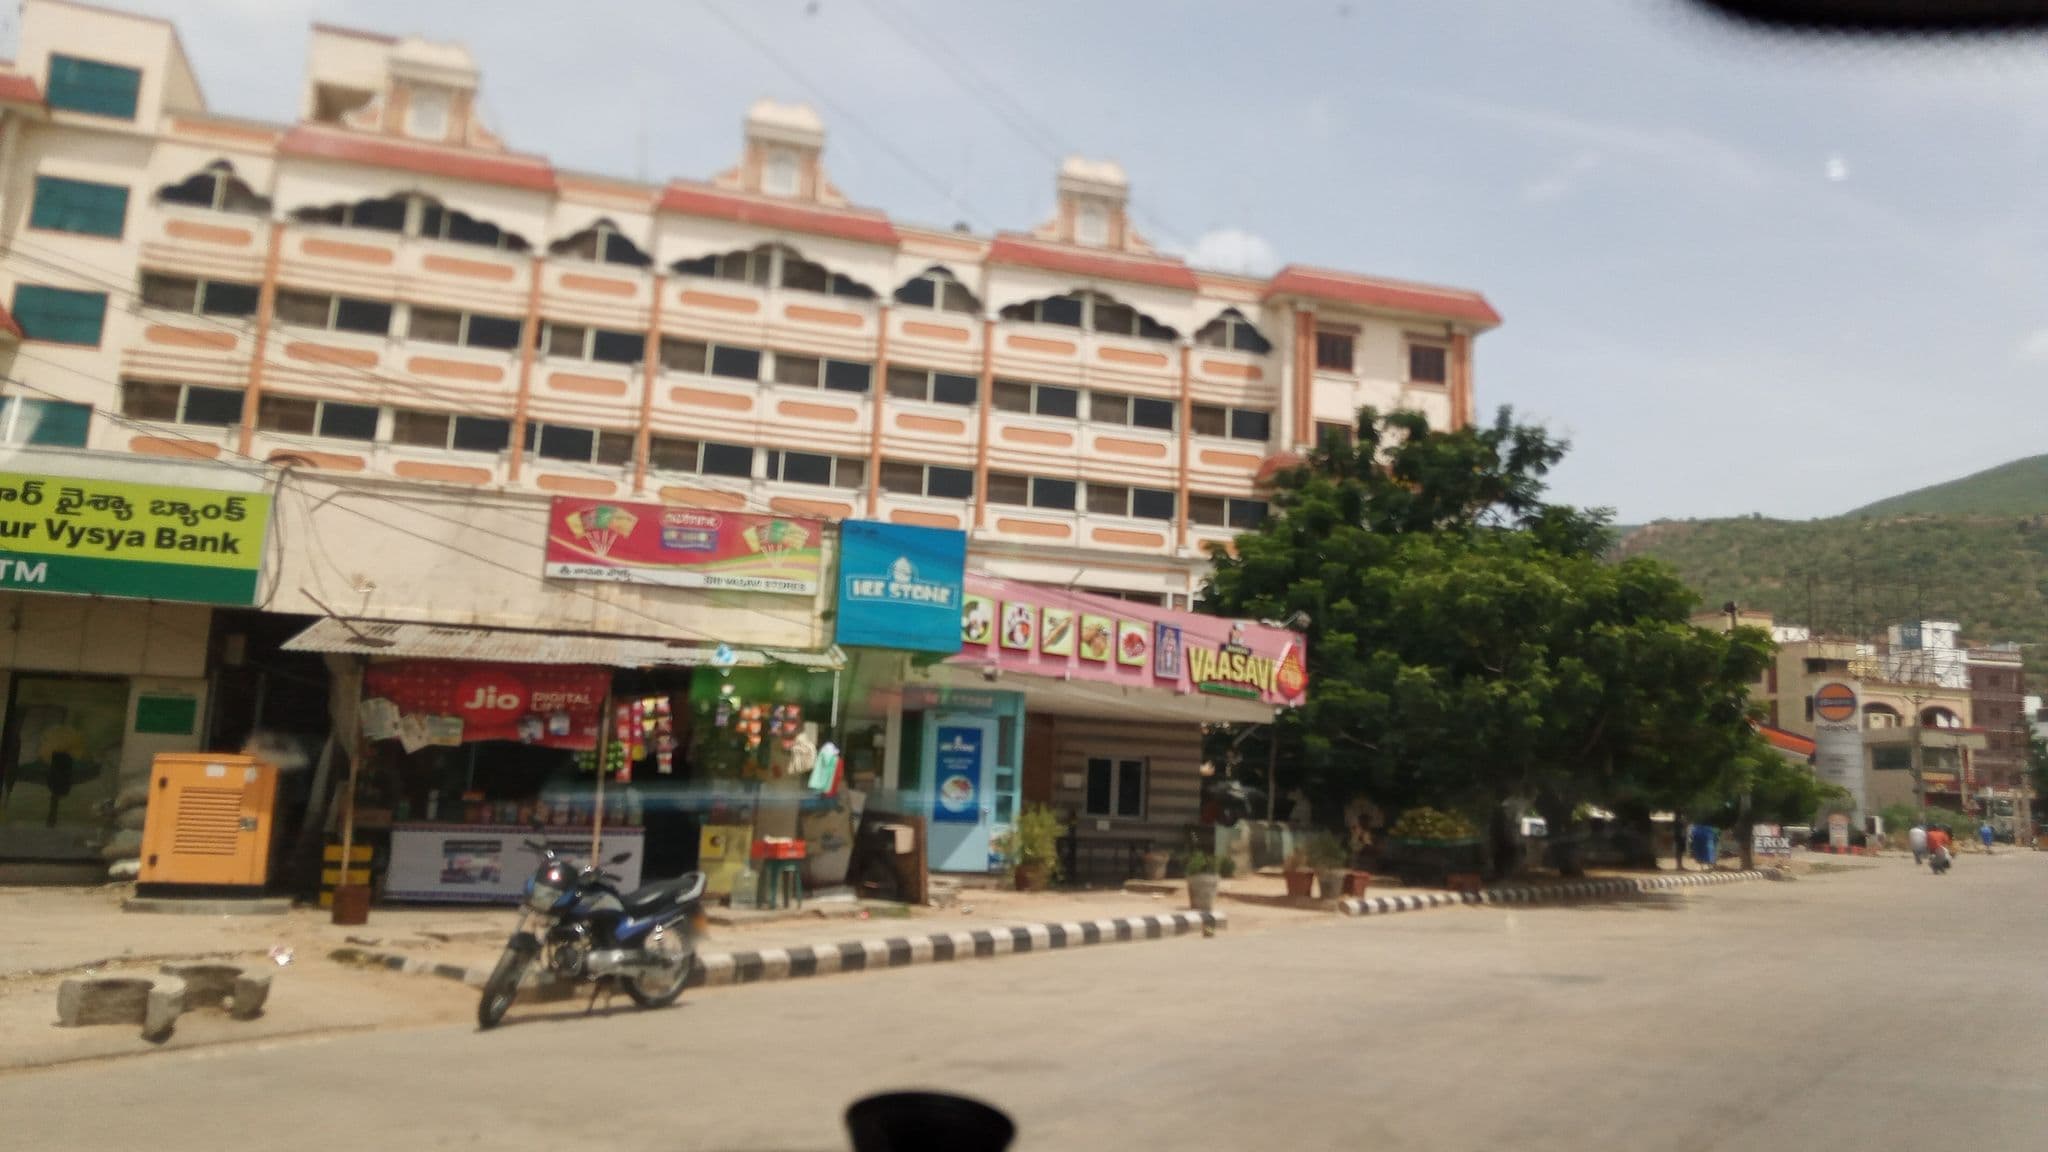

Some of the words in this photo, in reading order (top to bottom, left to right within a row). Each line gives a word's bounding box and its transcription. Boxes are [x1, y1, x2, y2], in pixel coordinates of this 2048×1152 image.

[45, 518, 145, 552] Vysya
[154, 527, 241, 554] Bank
[1188, 646, 1278, 694] VAASAVI
[463, 685, 520, 710] Jio
